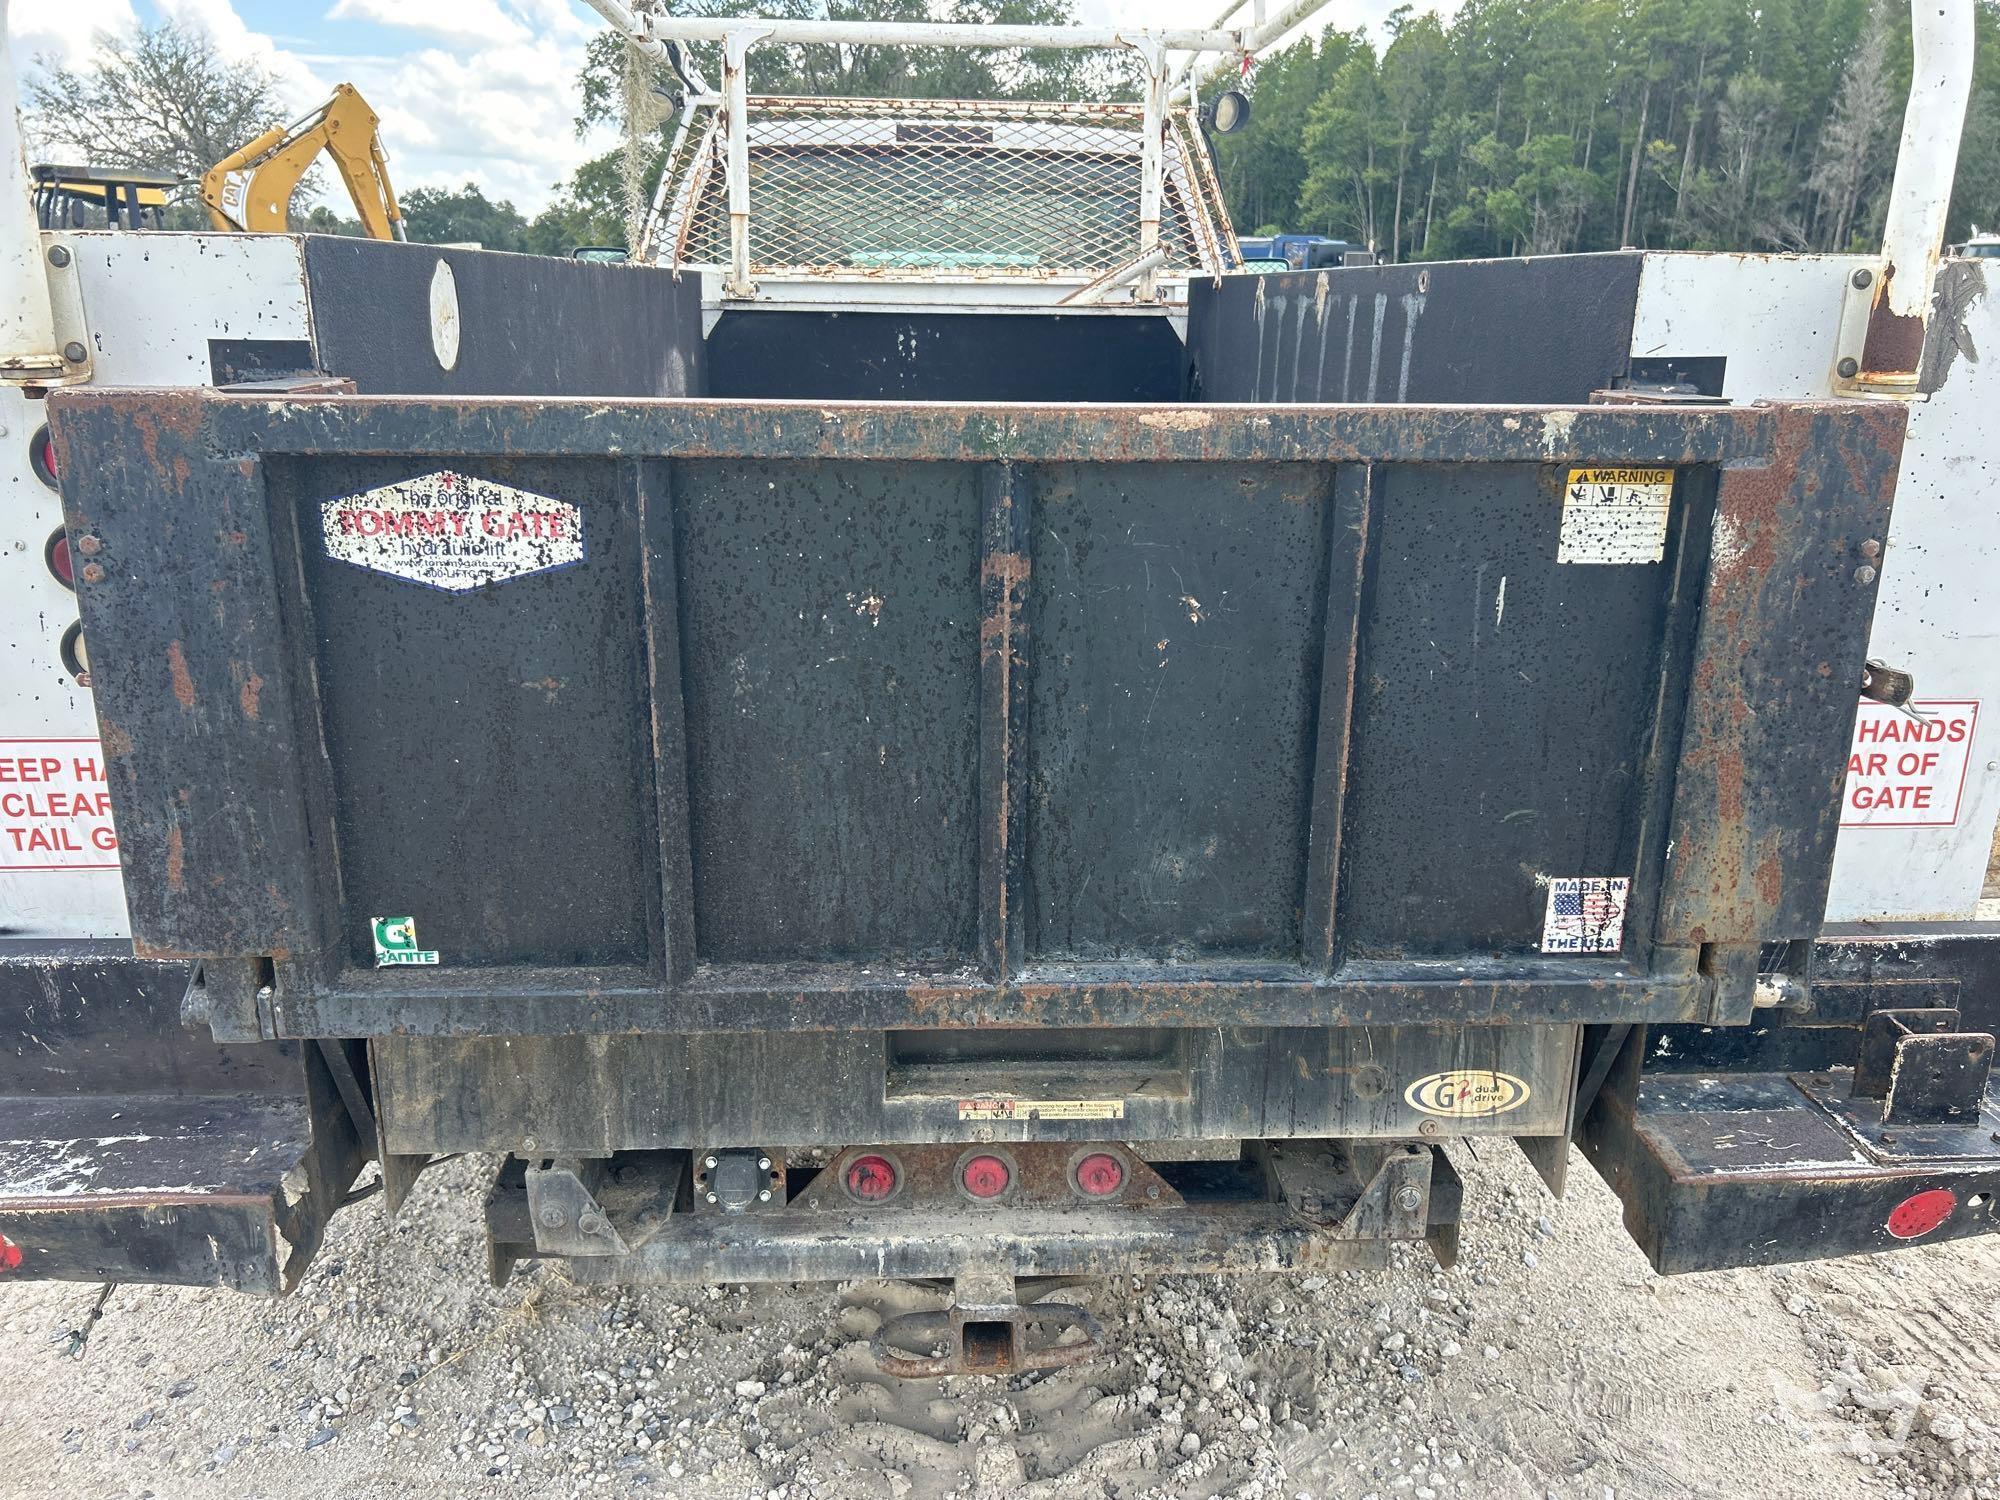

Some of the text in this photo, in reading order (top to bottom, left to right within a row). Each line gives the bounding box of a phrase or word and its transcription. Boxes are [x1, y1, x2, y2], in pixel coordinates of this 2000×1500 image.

[223, 178, 242, 207] CAT
[1593, 470, 1666, 483] WARNING
[398, 489, 504, 510] The original
[336, 510, 566, 538] TOMMY GATE
[486, 540, 506, 556] lift
[1858, 719, 1967, 743] HANDS
[0, 758, 61, 782] EEP
[1848, 753, 1940, 776] AR OF
[1851, 786, 1933, 809] GATE
[6, 827, 117, 851] TAIL G
[1555, 881, 1601, 892] MADE
[1547, 938, 1615, 949] THE USA
[1474, 1094, 1504, 1102] drive
[1475, 1085, 1500, 1094] dual
[973, 1101, 1010, 1109] DANGR
